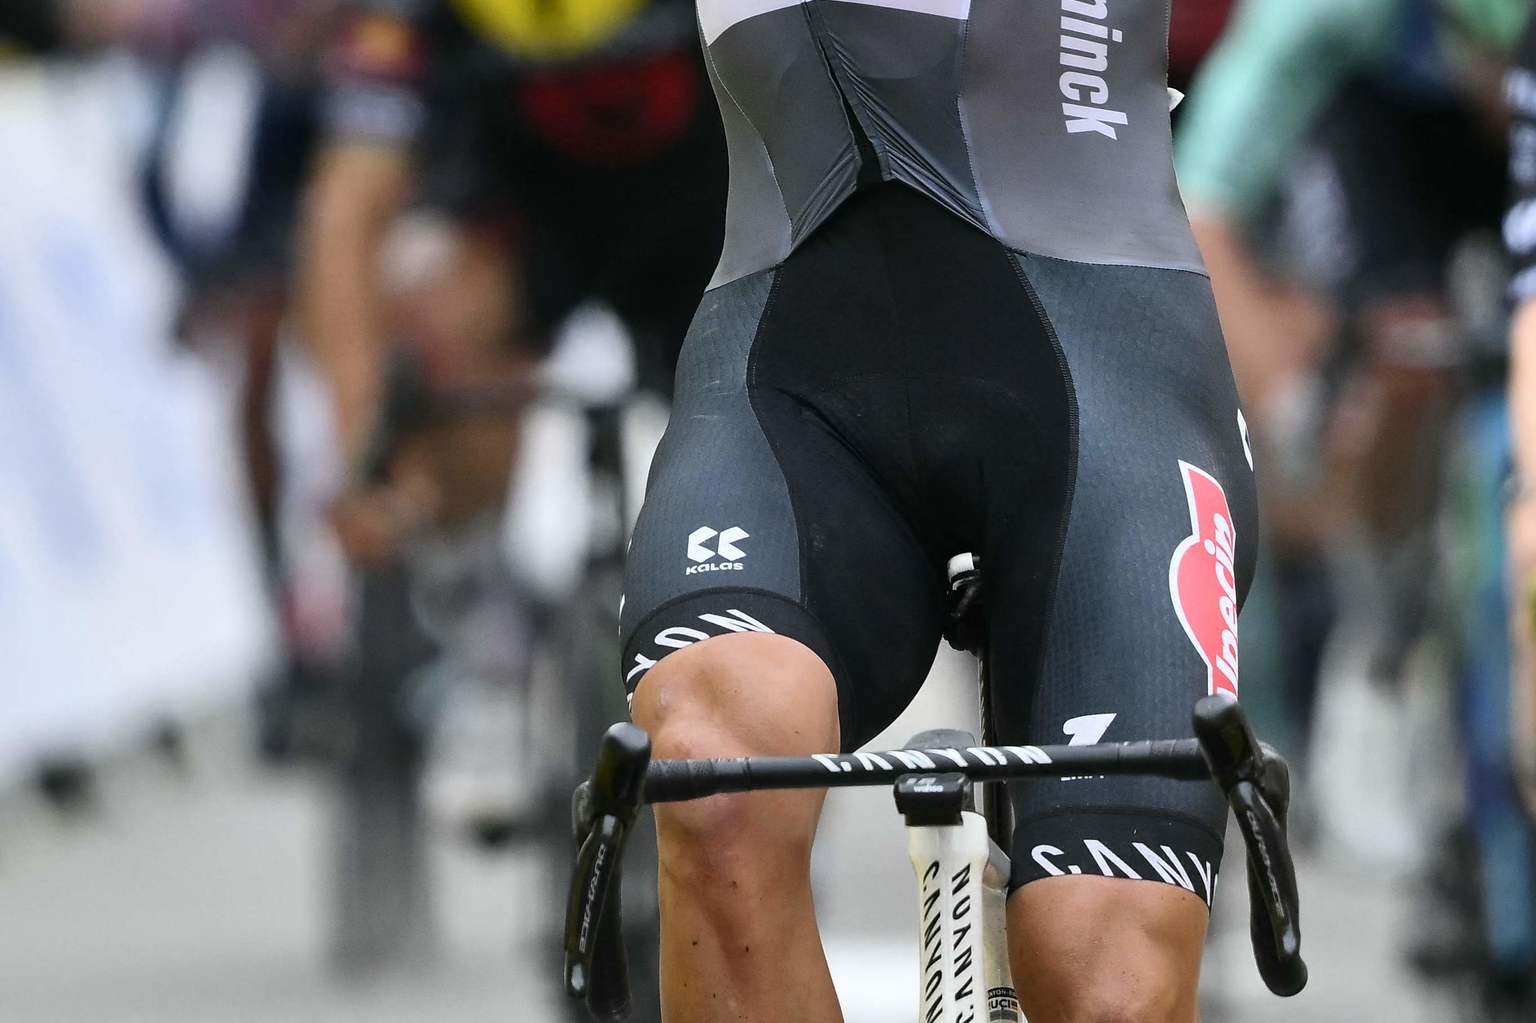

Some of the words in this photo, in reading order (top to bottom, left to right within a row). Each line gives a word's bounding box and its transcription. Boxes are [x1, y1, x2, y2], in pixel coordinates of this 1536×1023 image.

[1213, 512, 1238, 702] lpecin
[812, 746, 1053, 773] CANYON
[1031, 839, 1218, 908] CANY
